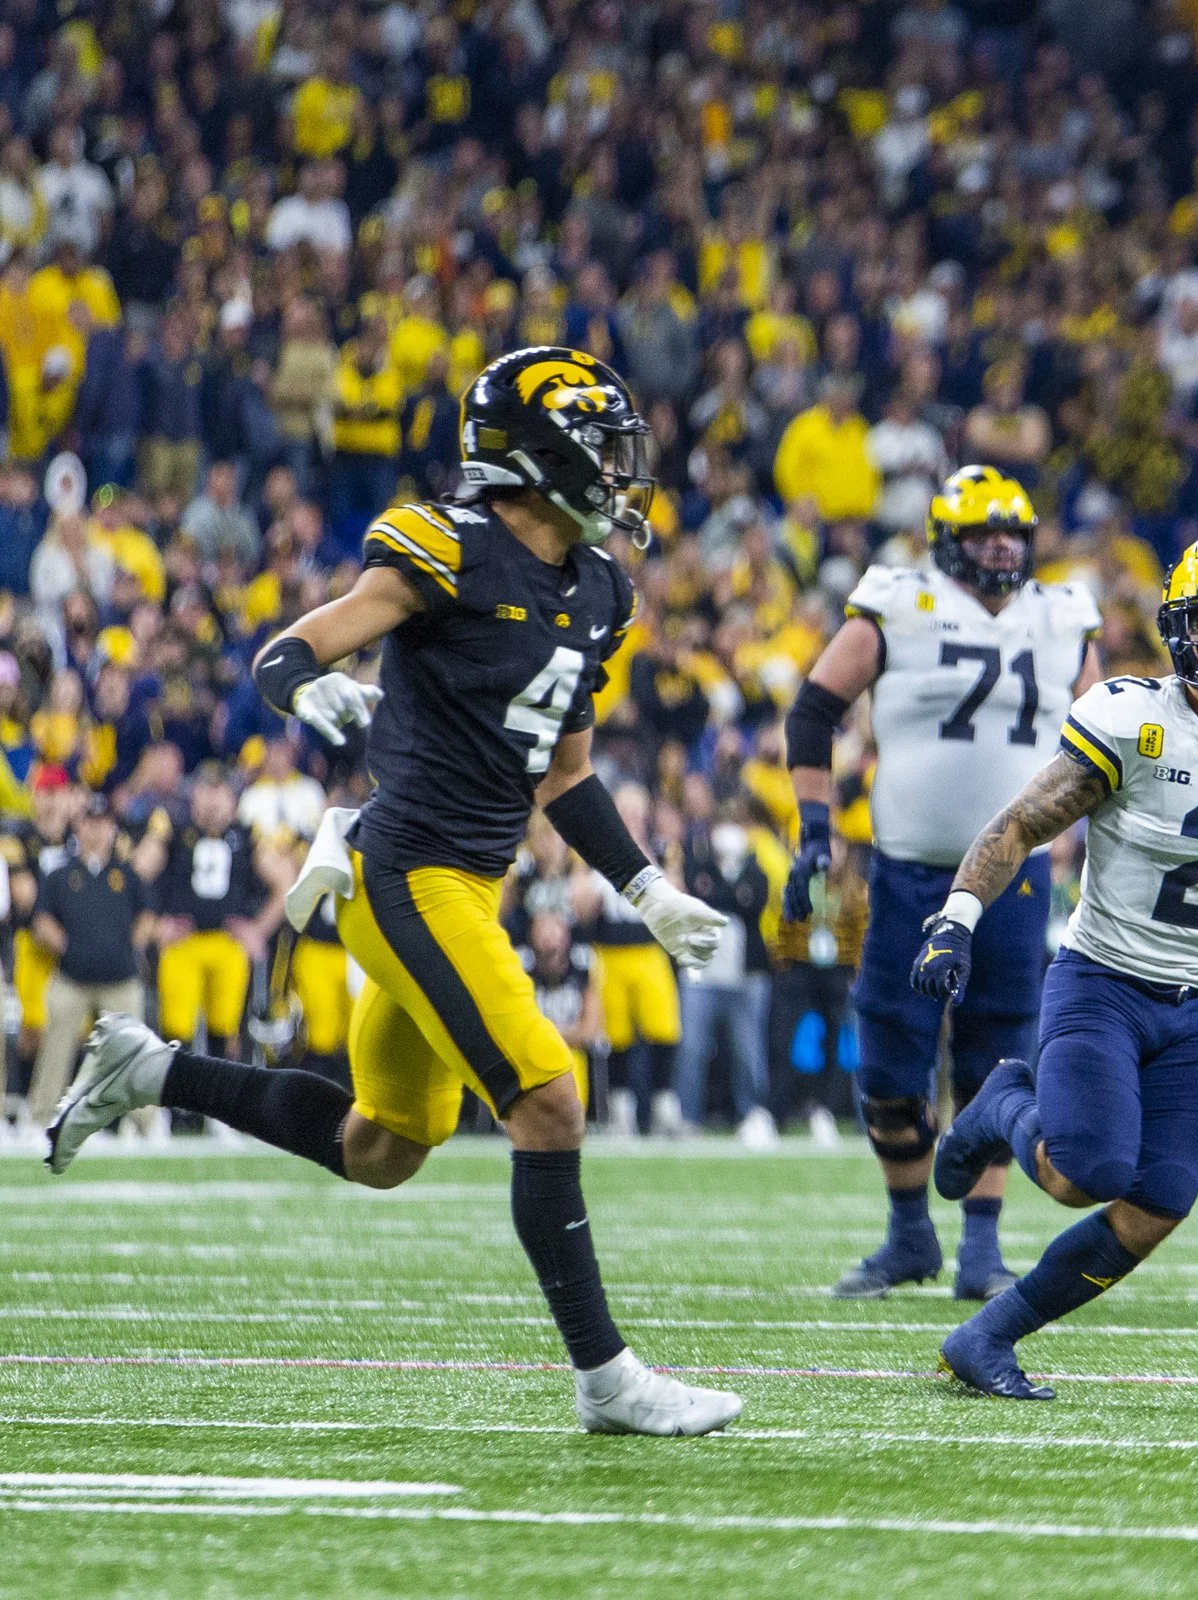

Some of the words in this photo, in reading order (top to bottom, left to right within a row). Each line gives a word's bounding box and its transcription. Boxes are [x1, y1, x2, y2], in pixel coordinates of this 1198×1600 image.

[463, 420, 476, 453] 4
[938, 640, 1040, 746] 71
[503, 646, 586, 774] 4
[1153, 764, 1191, 785] BIG
[632, 868, 658, 892] TIGER
